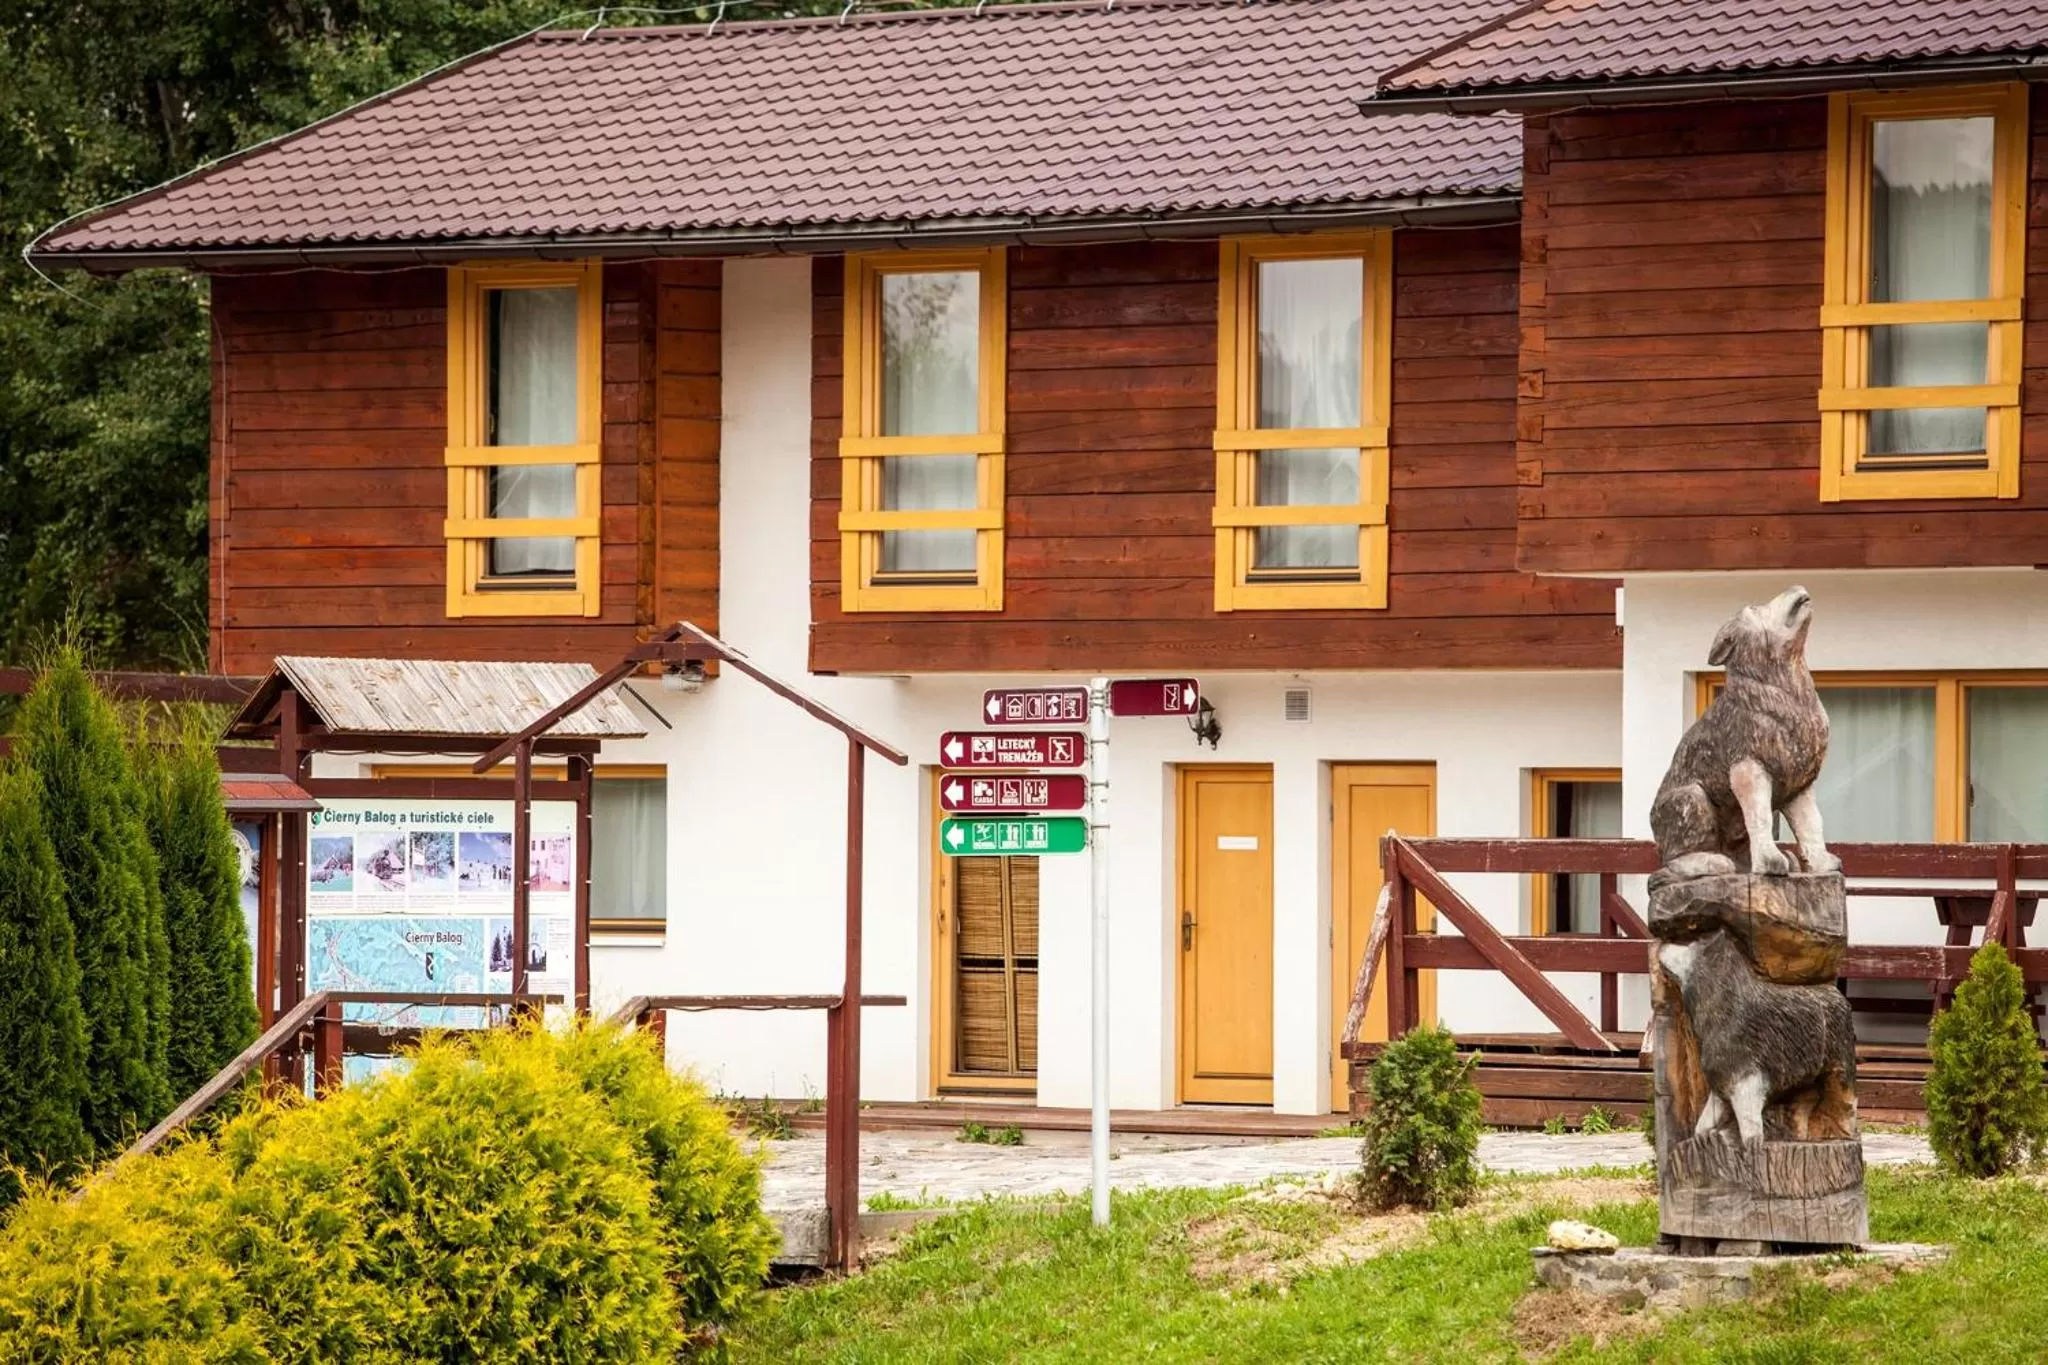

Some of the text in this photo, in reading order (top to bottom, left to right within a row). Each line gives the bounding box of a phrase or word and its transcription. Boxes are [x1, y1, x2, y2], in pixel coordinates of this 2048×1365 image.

[998, 737, 1035, 750] LETECKÝ
[998, 750, 1043, 763] TRENAŽÉR
[324, 808, 494, 825] Čierny Balog a turistické ciele
[436, 931, 462, 946] Balog
